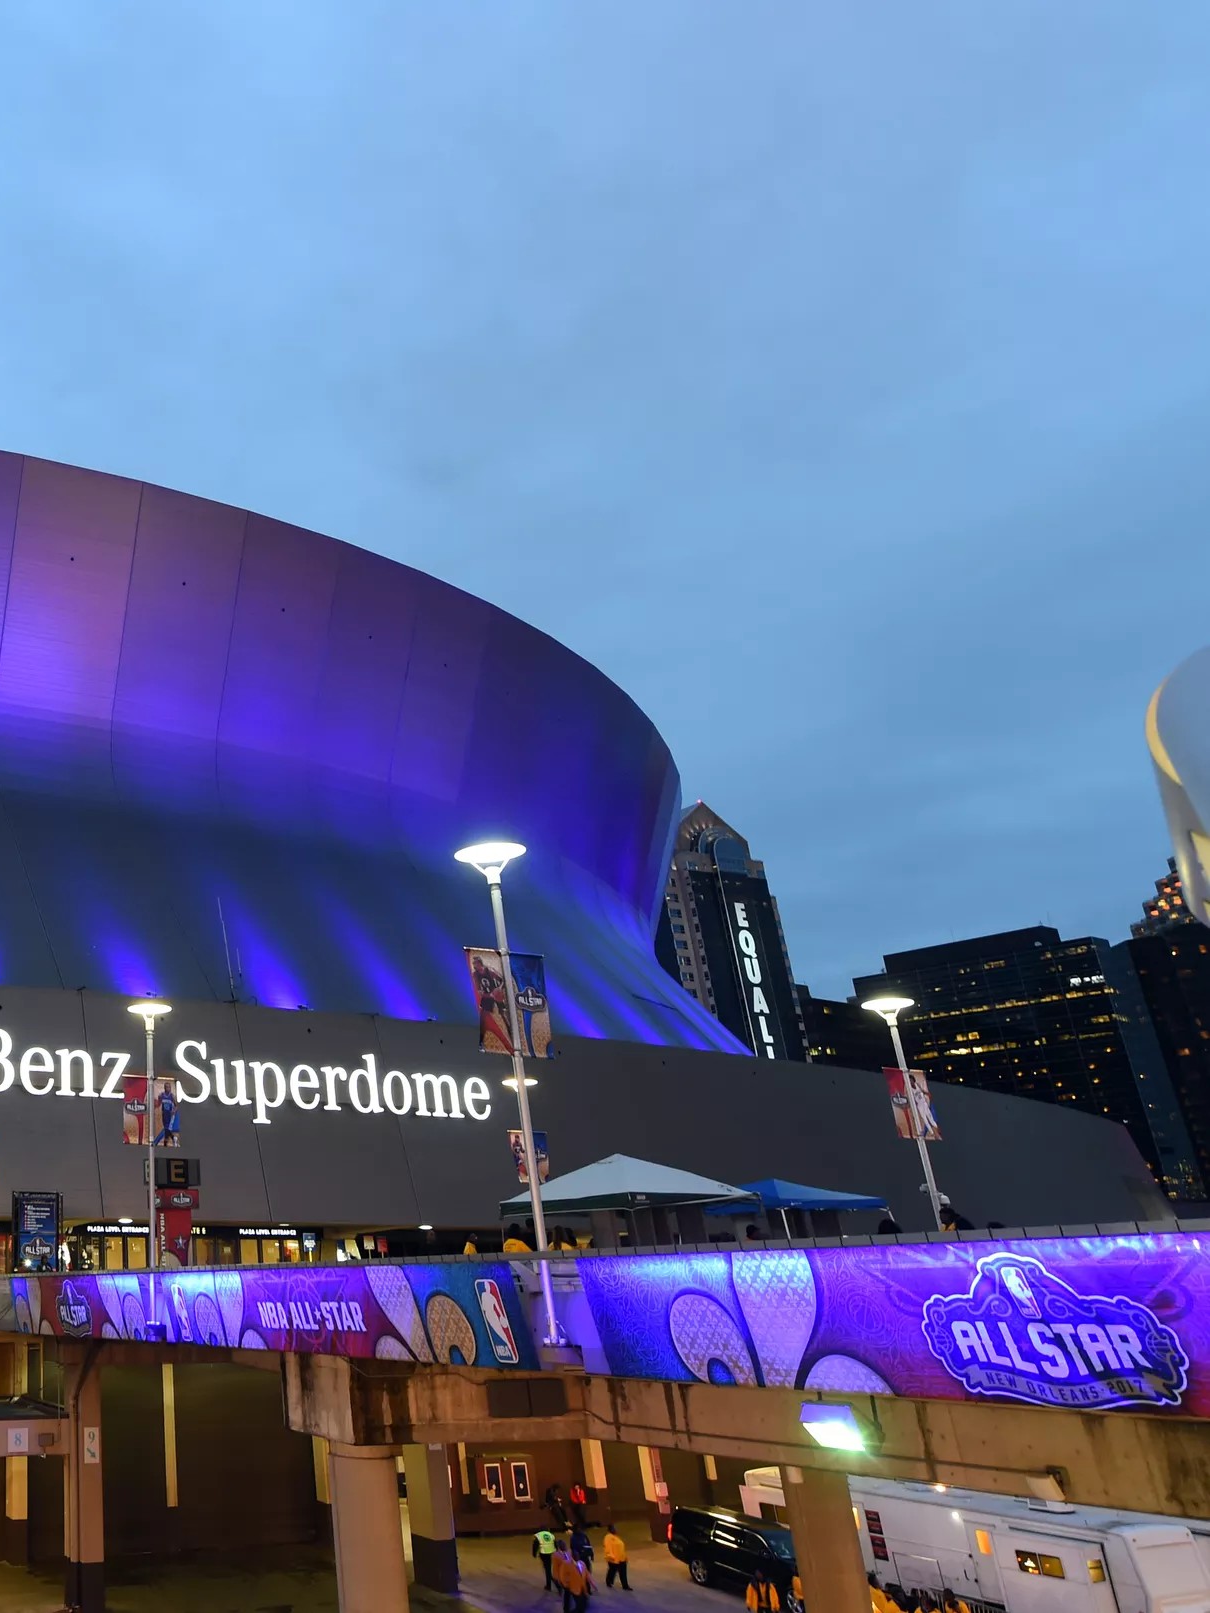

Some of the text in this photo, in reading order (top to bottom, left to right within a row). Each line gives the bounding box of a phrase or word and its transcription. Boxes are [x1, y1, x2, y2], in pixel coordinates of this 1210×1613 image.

[175, 1040, 492, 1124] Superdome
[170, 1160, 185, 1182] E
[257, 1301, 290, 1329] NBA
[495, 1345, 512, 1357] NBA
[985, 1371, 1143, 1402] NEW ORLEANS 2017
[14, 1433, 22, 1446] 8
[88, 1431, 95, 1443] 9
